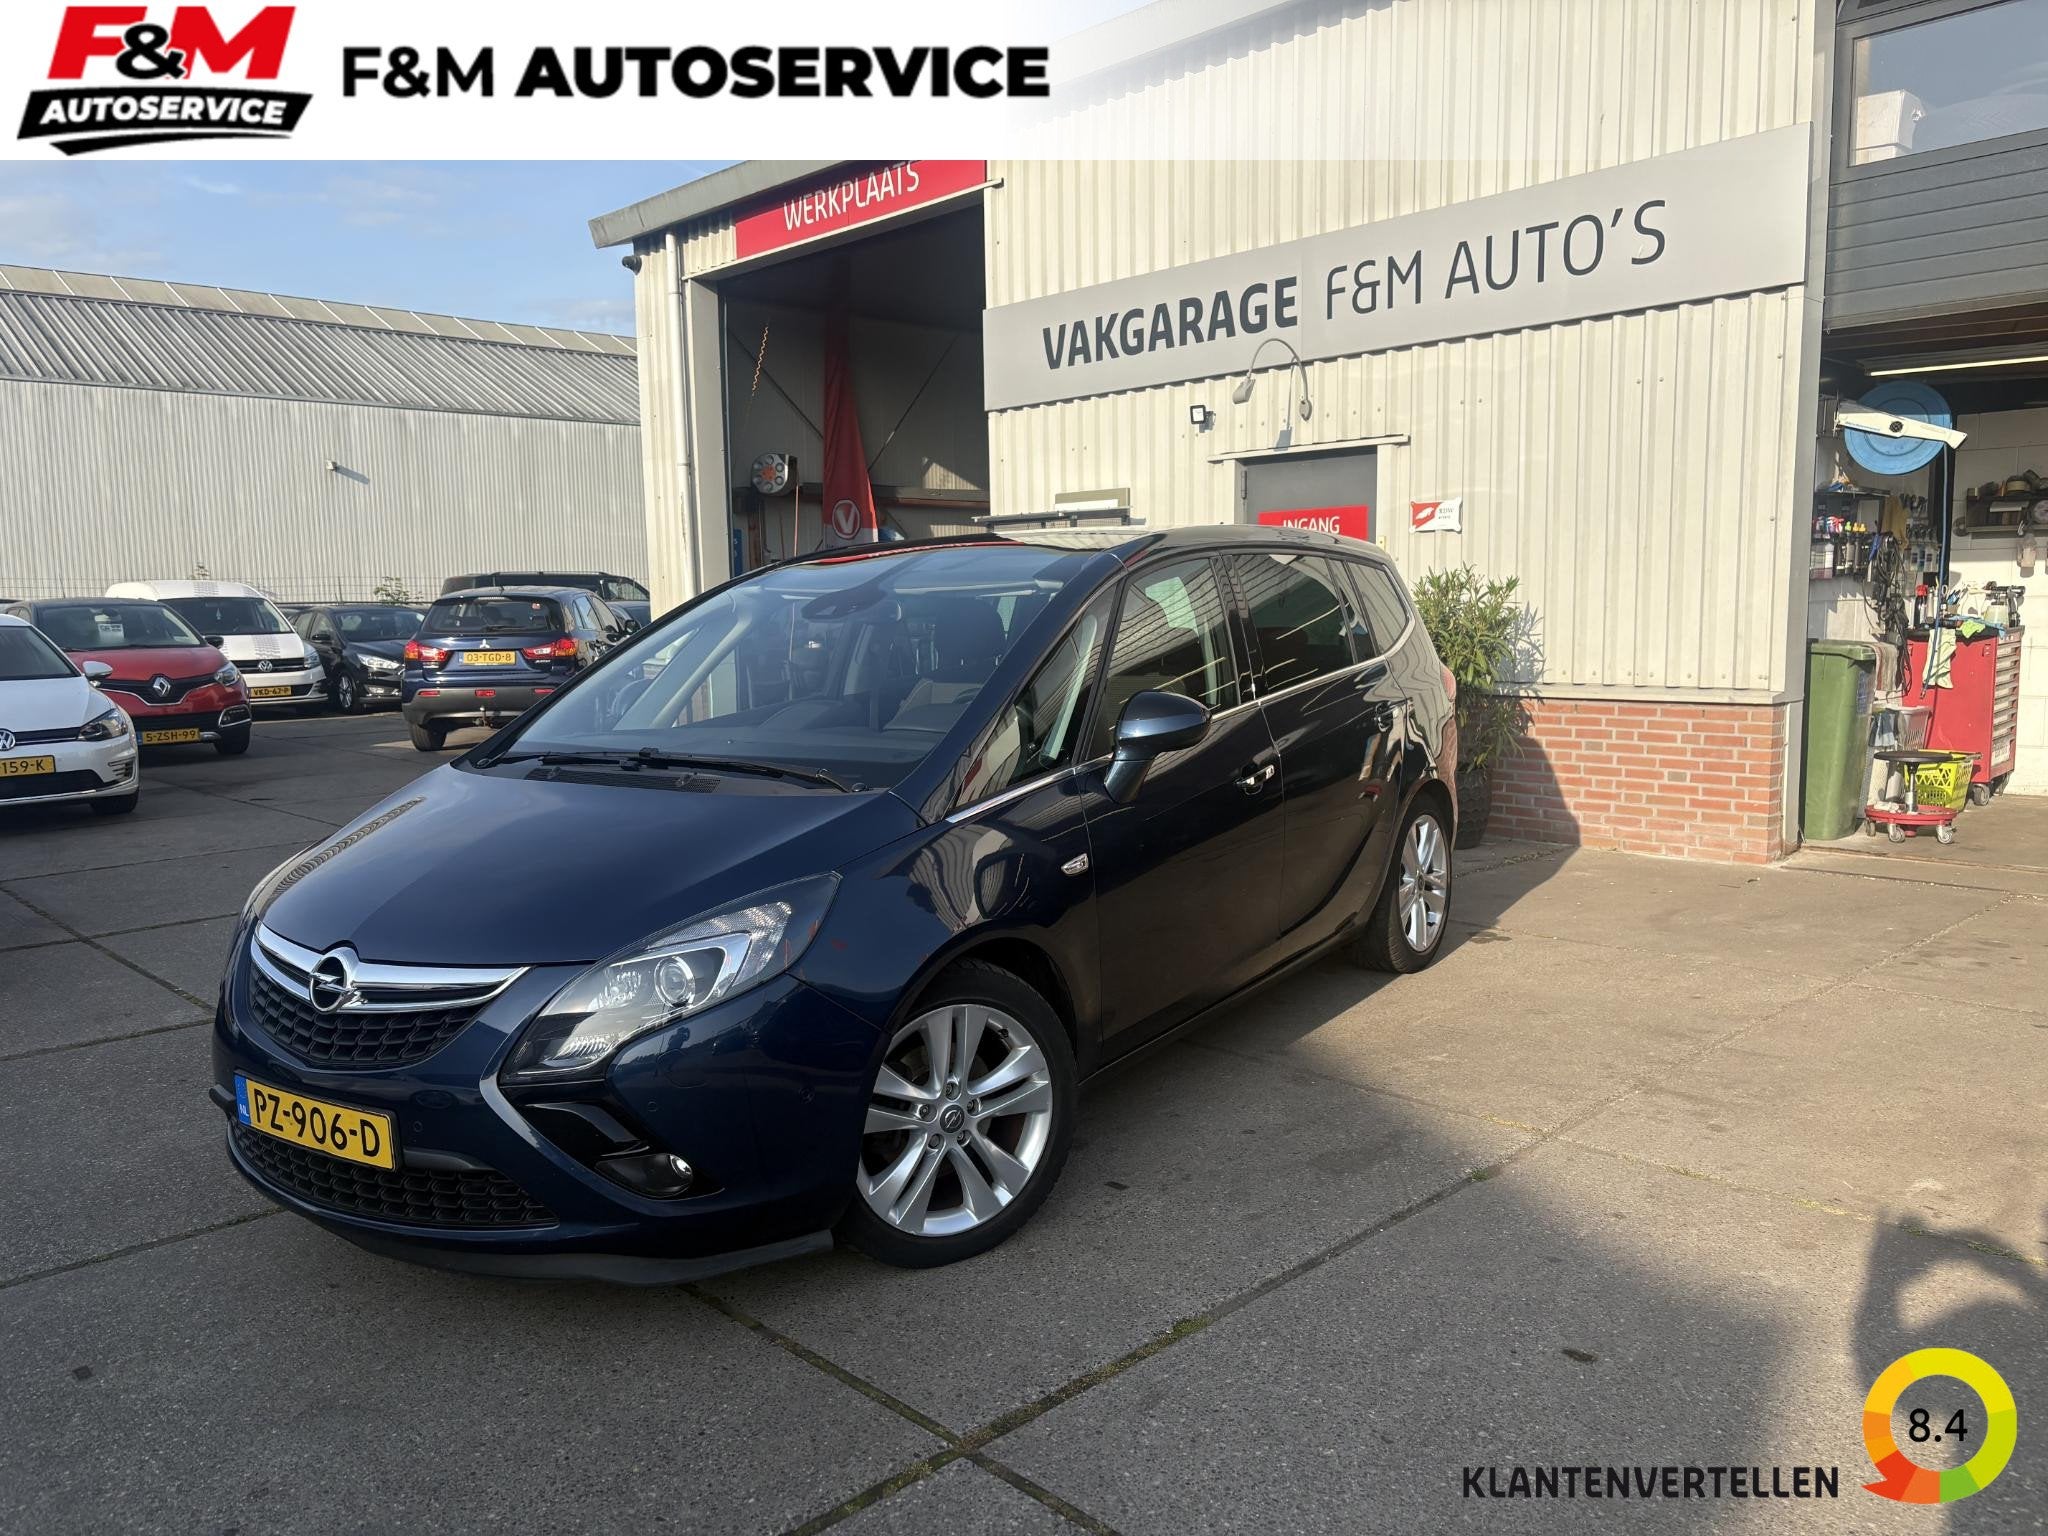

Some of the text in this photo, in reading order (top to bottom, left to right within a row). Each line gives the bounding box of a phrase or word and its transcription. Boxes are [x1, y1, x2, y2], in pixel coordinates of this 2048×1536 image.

[783, 160, 920, 231] WERKPLAATS
[1042, 200, 1666, 370] VAKGARAGE F&M AUTO'S
[466, 653, 512, 662] 03-TGD-8
[0, 759, 46, 774] 159-K
[253, 1088, 381, 1157] PZ-906-D
